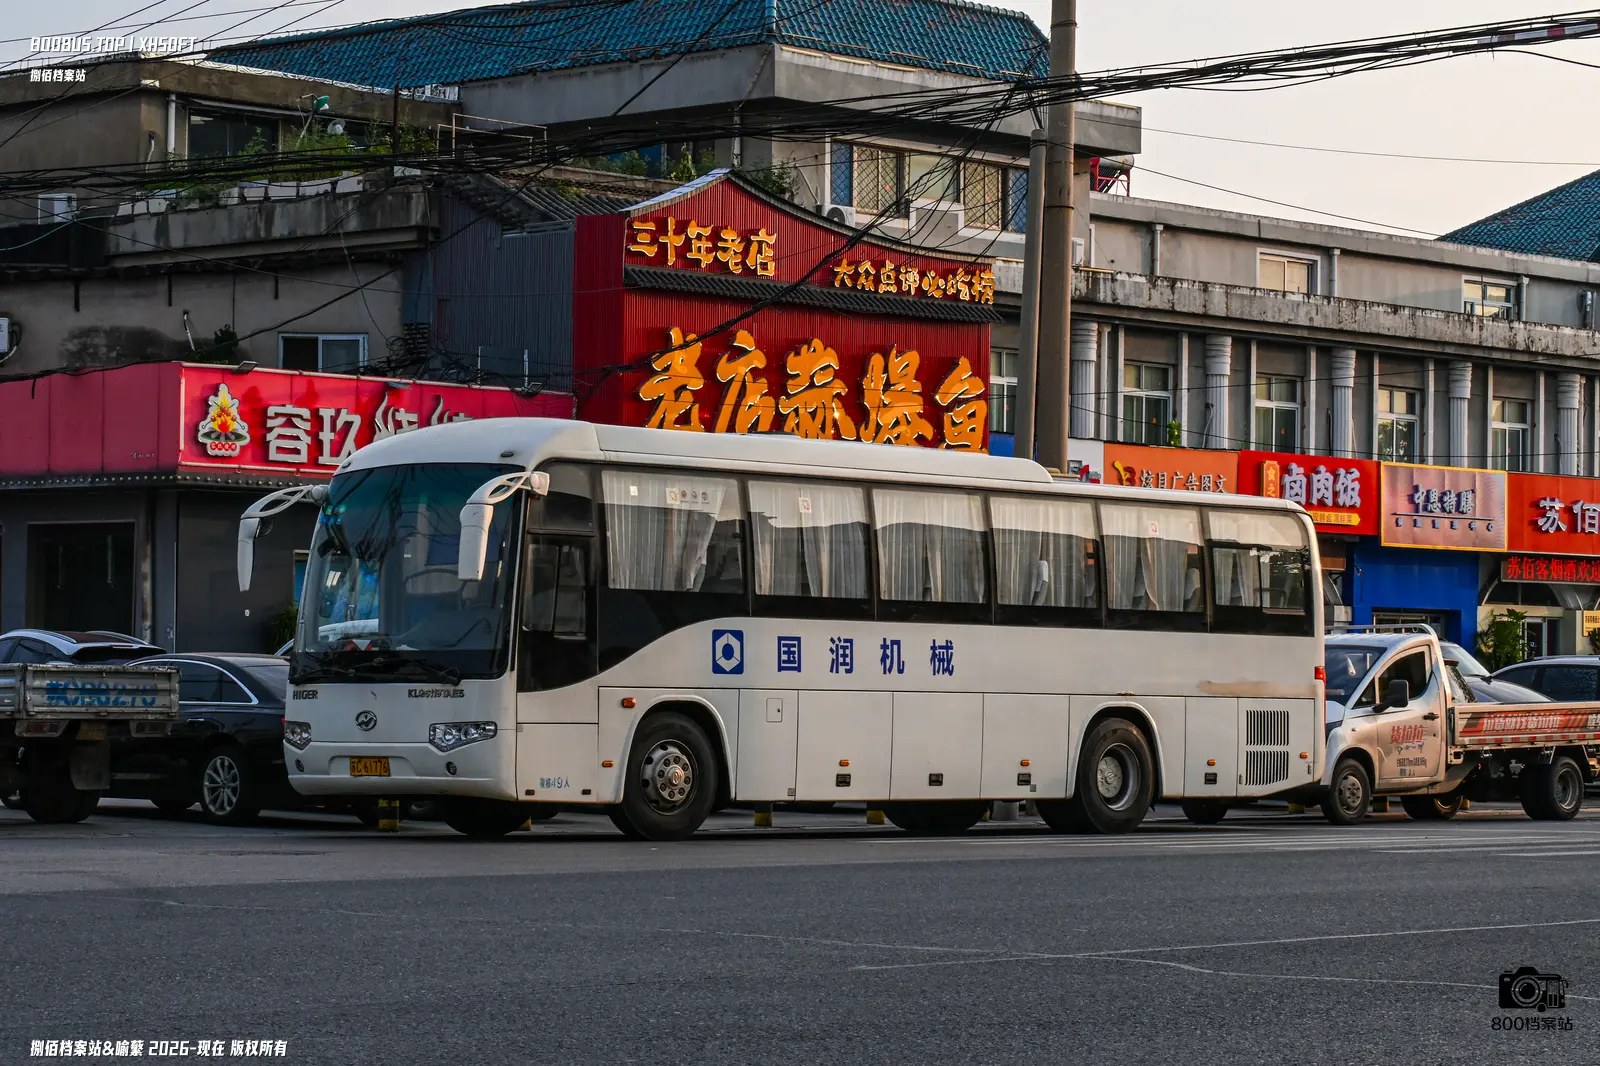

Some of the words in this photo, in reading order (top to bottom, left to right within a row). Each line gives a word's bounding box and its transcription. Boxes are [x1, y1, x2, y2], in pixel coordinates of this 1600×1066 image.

[628, 216, 777, 277] 三十年老店
[834, 258, 996, 305] 大众点评必吃榜
[266, 391, 473, 466] 容玖烧
[1282, 462, 1361, 508] 卤肉饭
[777, 635, 955, 676] 国润机械
[292, 689, 318, 700] HIGER
